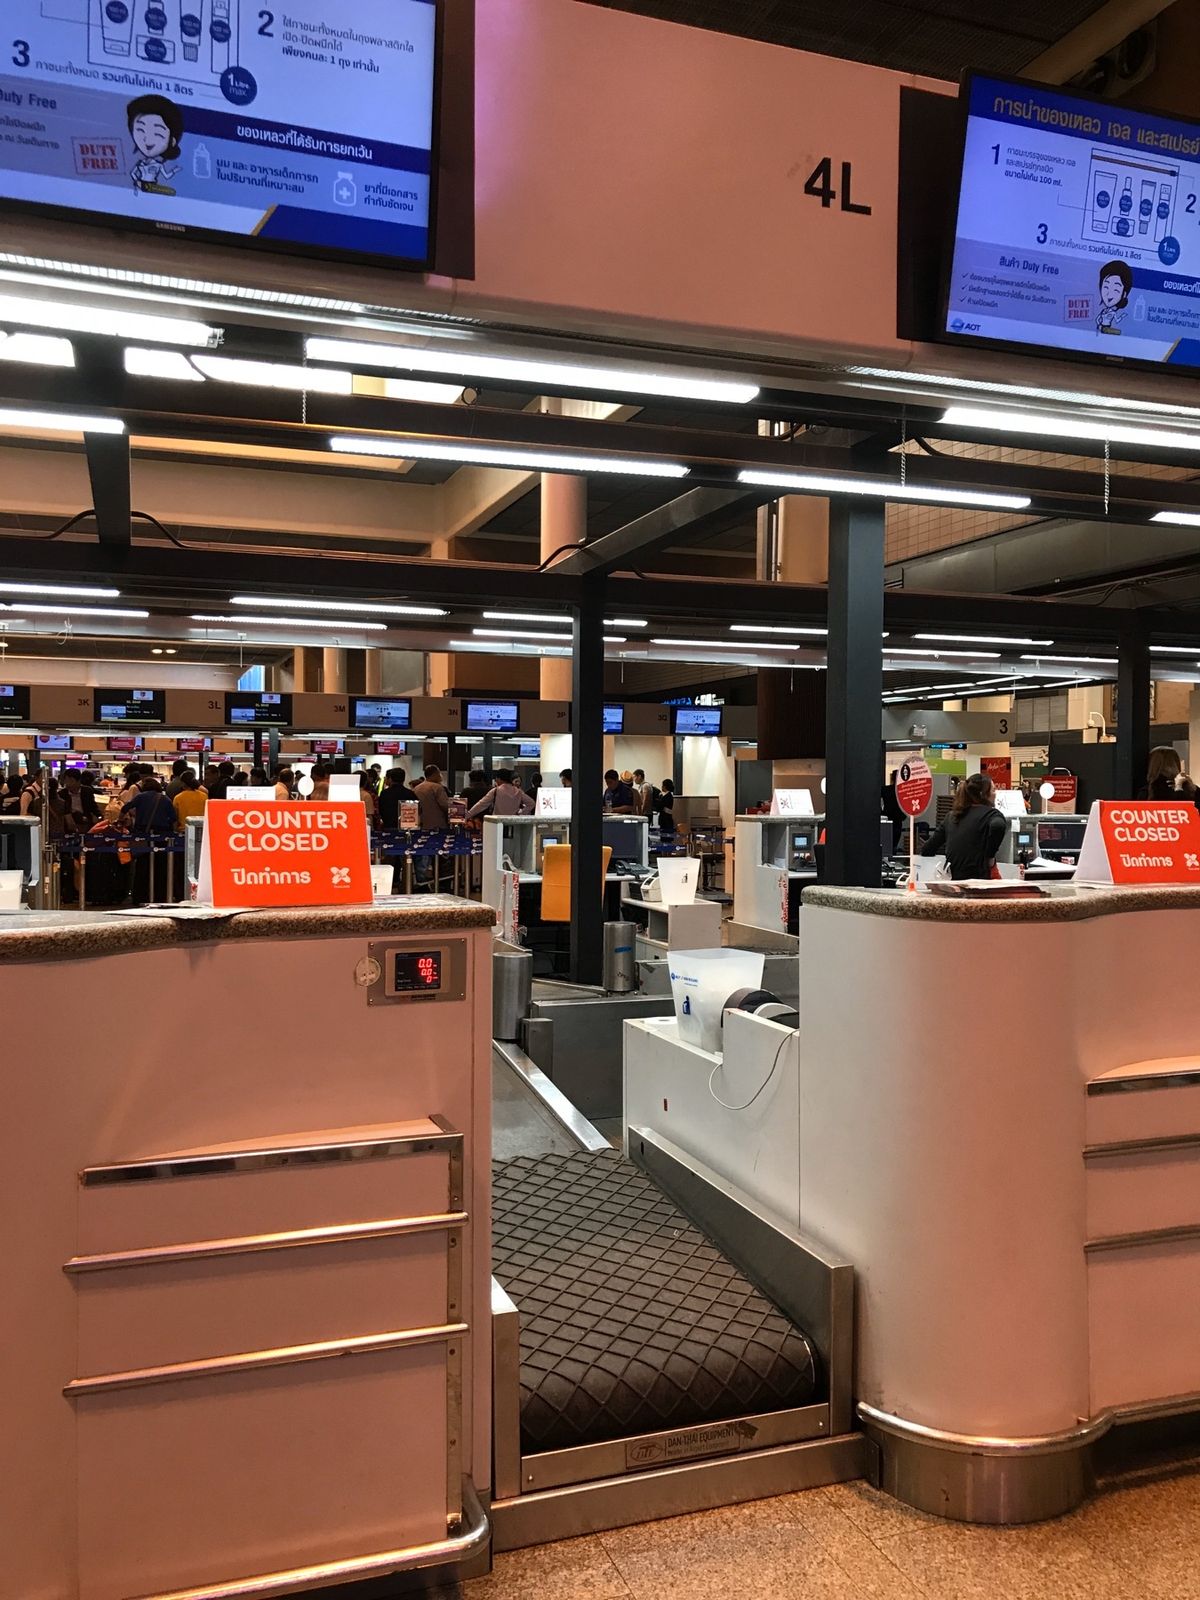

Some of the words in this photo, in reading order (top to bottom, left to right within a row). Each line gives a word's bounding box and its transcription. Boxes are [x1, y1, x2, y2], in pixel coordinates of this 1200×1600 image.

[258, 10, 274, 37] 2
[12, 40, 30, 67] 3
[330, 55, 336, 65] 1
[165, 82, 171, 92] 1
[29, 93, 57, 109] Free
[79, 143, 118, 157] DUTY
[991, 143, 1001, 165] 1
[81, 158, 119, 170] FREE
[804, 156, 872, 216] 4L
[1039, 175, 1052, 185] 100
[1185, 193, 1197, 214] 2
[1036, 222, 1049, 245] 3
[1022, 260, 1040, 274] Duty
[1042, 263, 1060, 276] Free
[1068, 299, 1091, 309] DUTY
[1068, 309, 1090, 319] FREE
[964, 323, 982, 332] AOT
[77, 698, 90, 707] 3K
[207, 700, 222, 710] 3L
[999, 718, 1009, 735] 3
[227, 810, 348, 829] COUNTER
[1110, 810, 1190, 825] COUNTER
[1114, 827, 1180, 842] CLOSED
[228, 833, 330, 852] CLOSED
[1120, 853, 1174, 868] ปิดทำการ
[231, 866, 311, 885] ปิดทำการ
